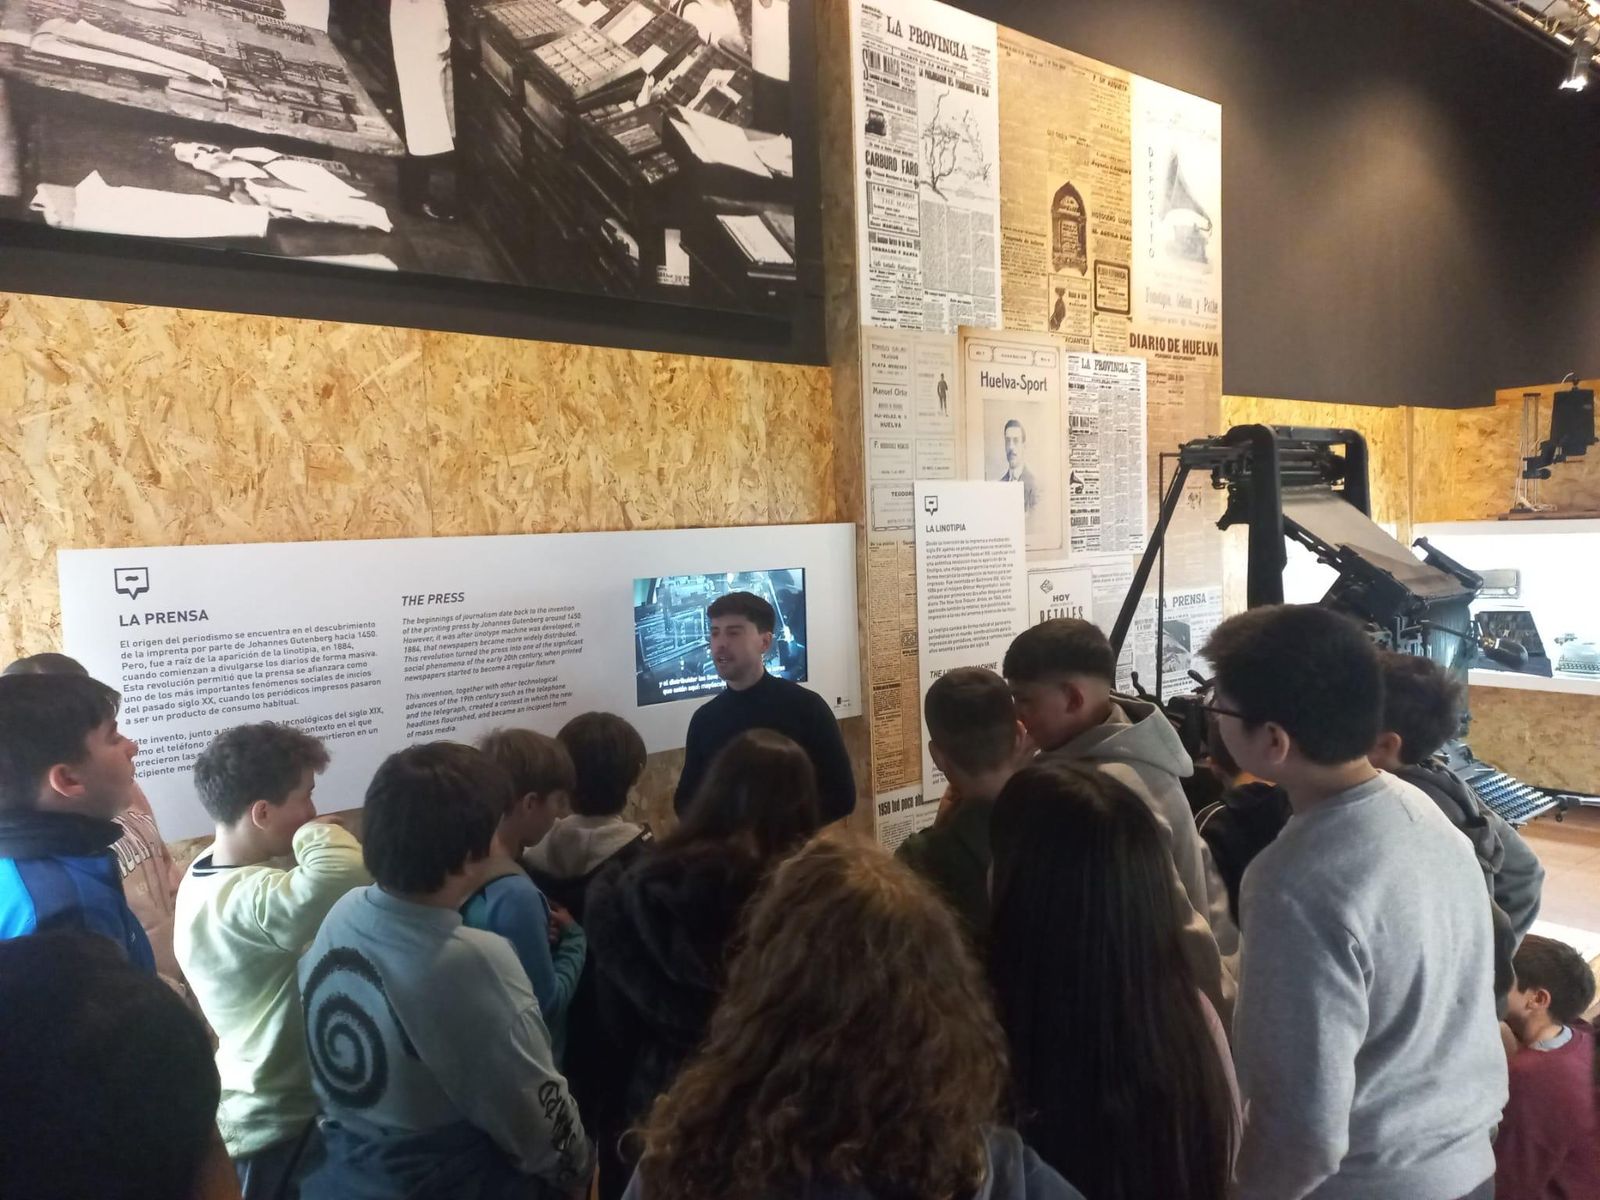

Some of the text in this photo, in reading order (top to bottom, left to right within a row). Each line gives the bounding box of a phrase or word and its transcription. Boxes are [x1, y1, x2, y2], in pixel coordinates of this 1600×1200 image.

[887, 15, 903, 38] LA
[909, 25, 968, 60] PROVINCIA
[866, 150, 898, 172] CARBURO
[1130, 332, 1218, 357] DIARIO DE HUELVA
[1082, 358, 1128, 373] LA PROVINCIA
[936, 524, 966, 532] LINOTIPIA
[402, 593, 465, 607] THE PRESS
[1053, 594, 1070, 602] HOY
[1172, 593, 1206, 608] PRENSA
[119, 610, 209, 627] LA PRENSA
[121, 640, 130, 649] El
[133, 639, 163, 648] origen
[166, 636, 180, 645] del
[183, 633, 233, 645] periodismo
[248, 629, 290, 638] encuentra
[305, 625, 312, 633] el
[315, 621, 375, 632] descubrimiento
[148, 648, 188, 658] imprenta
[192, 647, 206, 655] por
[210, 644, 232, 654] parte
[248, 640, 288, 648] Johannes
[291, 635, 332, 645] Gutenberg
[335, 632, 355, 641] hacia
[123, 671, 157, 681] cuando
[160, 668, 208, 678] comienzan
[219, 662, 263, 672] divulgarse
[281, 657, 308, 666] diarios
[176, 657, 192, 665] raíz
[219, 651, 258, 663] aparición
[148, 678, 194, 690] revolución
[198, 674, 234, 687] permitió
[238, 674, 252, 683] que
[266, 670, 294, 680] prensa
[308, 664, 344, 674] afianzara
[175, 689, 193, 698] más
[197, 684, 250, 696] importantes
[253, 679, 298, 689] fenómenos
[301, 674, 333, 684] sociales
[347, 670, 371, 679] inicios
[125, 705, 140, 714] del
[143, 702, 175, 714] pasado
[179, 699, 199, 709] siglo
[219, 693, 250, 703] cuando
[268, 687, 309, 700] periódicos
[312, 683, 348, 694] impresos
[351, 679, 381, 690] pasaron
[167, 710, 206, 722] producto
[222, 704, 260, 713] consumo
[150, 733, 186, 743] invento,
[189, 730, 212, 740] junto
[349, 710, 367, 718] siglo
[168, 741, 204, 752] teléfono
